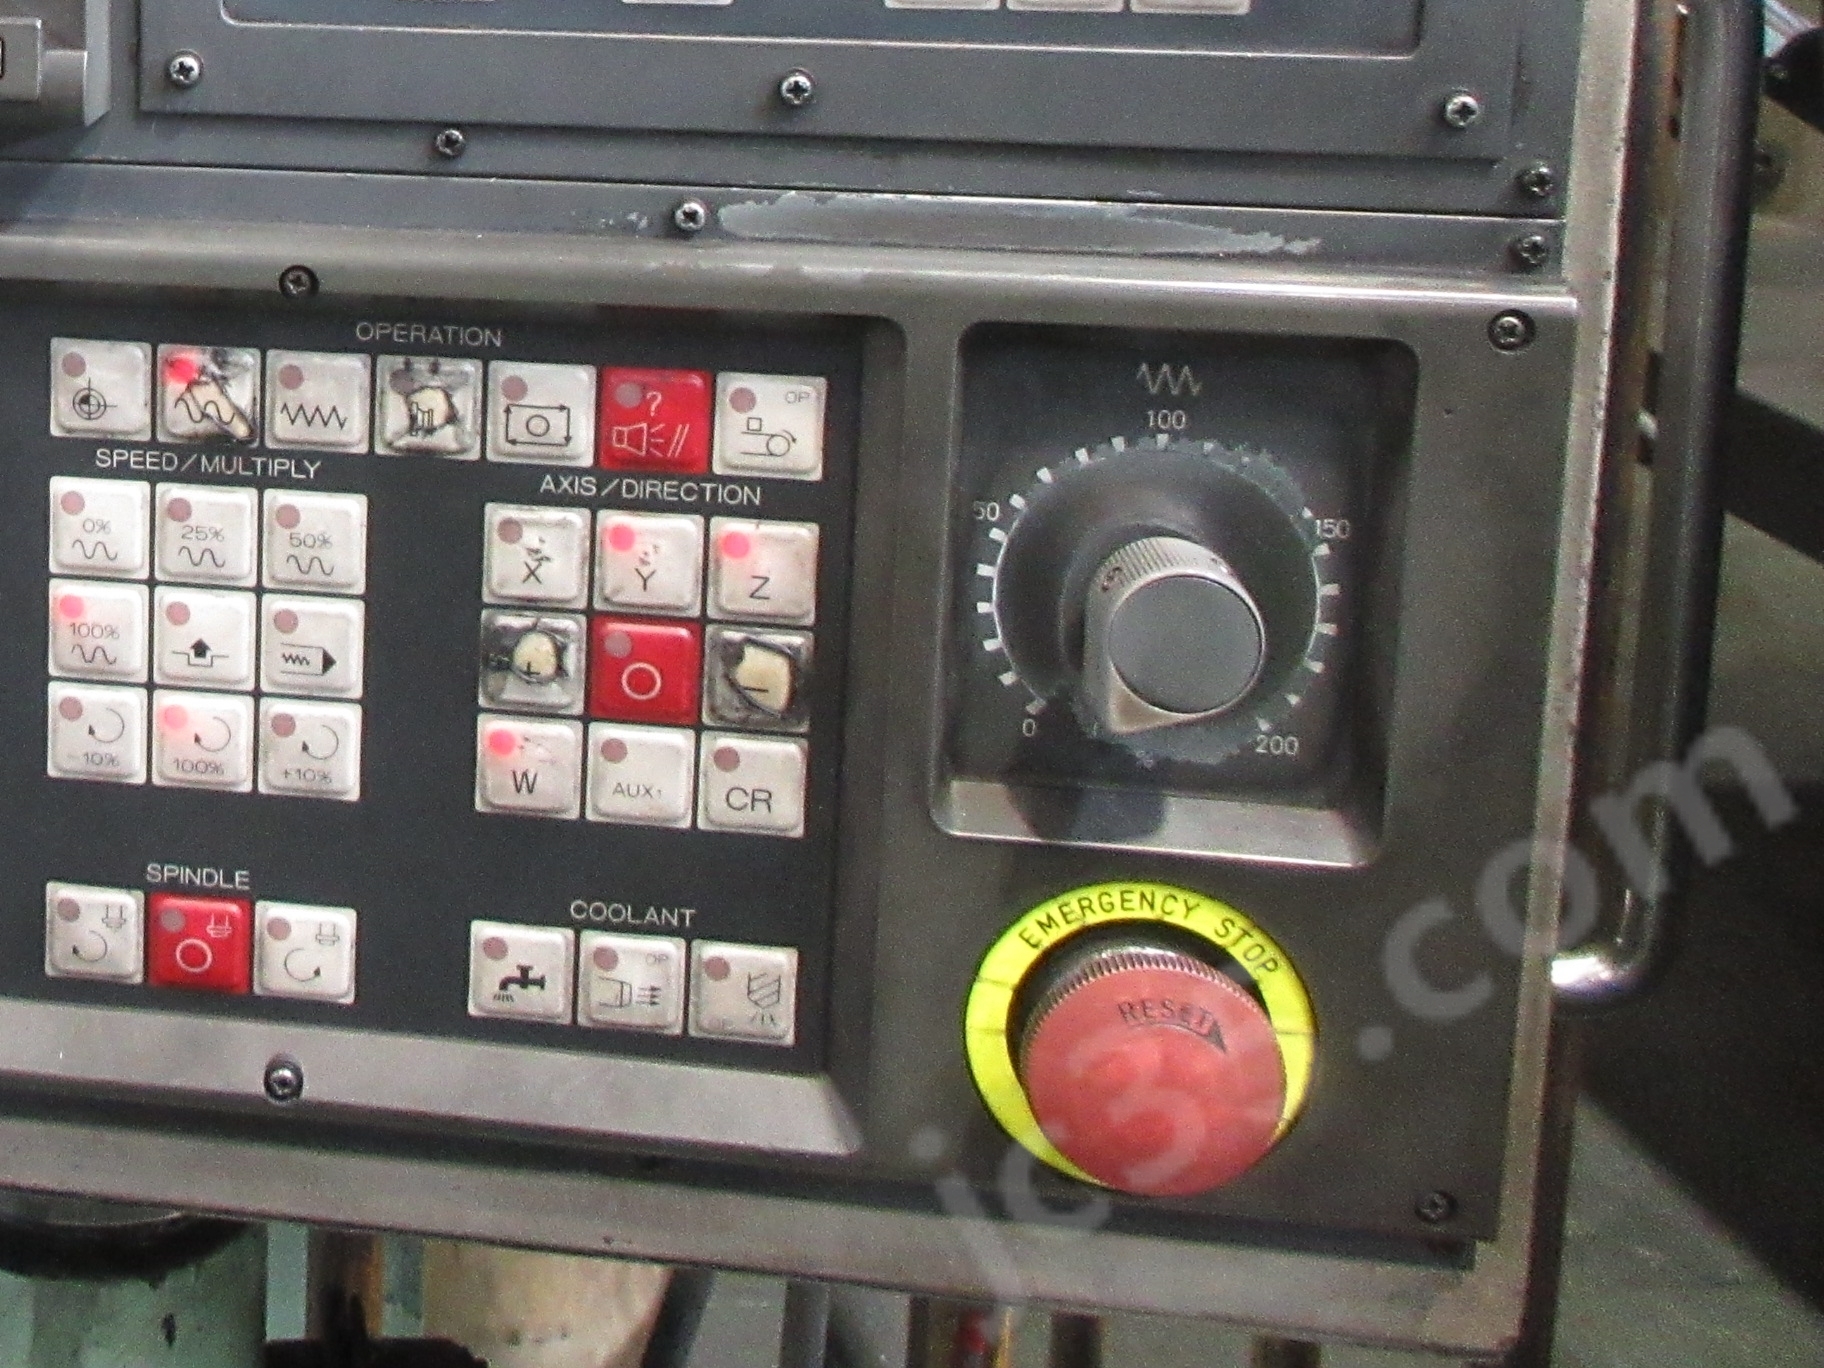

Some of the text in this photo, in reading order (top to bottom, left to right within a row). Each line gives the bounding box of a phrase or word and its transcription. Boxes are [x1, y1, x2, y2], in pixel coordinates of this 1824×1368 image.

[354, 320, 505, 350] OPERATION
[1144, 409, 1188, 430] 100
[94, 448, 322, 480] SPEED/MULTIPLY
[82, 518, 112, 536] 0%
[181, 524, 226, 544] 25%
[1313, 517, 1351, 540] 150
[288, 531, 334, 551] 50%
[521, 560, 543, 584] X
[635, 567, 657, 593] Y
[750, 575, 771, 600] Z
[69, 621, 120, 641] 100%
[1254, 734, 1301, 758] 200
[172, 756, 226, 777] 100%
[512, 769, 539, 795] W
[725, 786, 773, 813] CR
[144, 862, 252, 891] SPINDLE
[569, 899, 698, 929] COOLANT
[1017, 888, 1280, 976] EMERGENCY STOP
[1117, 997, 1214, 1025] RESET
